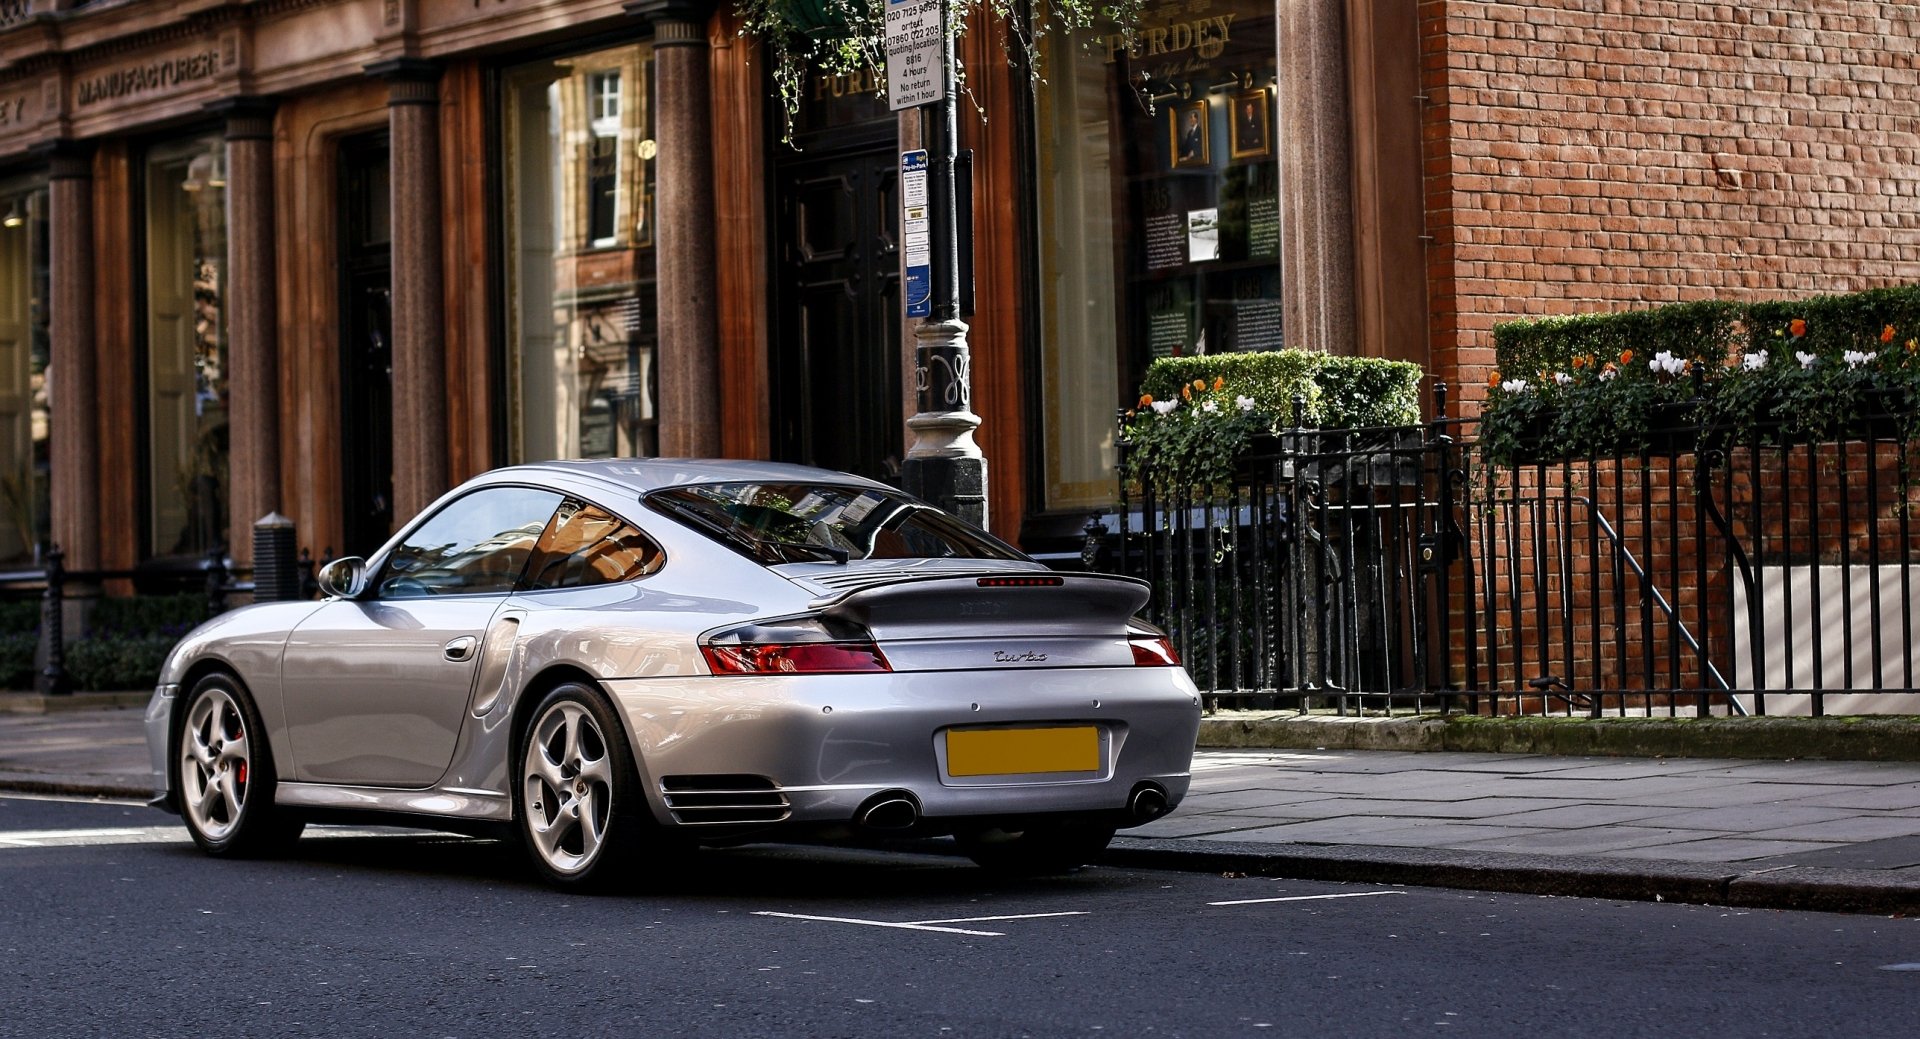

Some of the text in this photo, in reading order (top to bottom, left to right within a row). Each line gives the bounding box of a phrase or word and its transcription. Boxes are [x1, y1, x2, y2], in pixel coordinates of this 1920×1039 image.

[887, 11, 900, 22] 020
[902, 6, 917, 18] 7125
[902, 18, 924, 31] or text
[887, 25, 939, 46] 07860 022 205
[1104, 13, 1236, 64] PURDEY
[889, 38, 939, 57] quoting location
[906, 53, 922, 65] 8816
[903, 66, 927, 78] 4 hours
[900, 80, 930, 92] No return
[896, 95, 915, 105] within
[922, 90, 935, 99] hour
